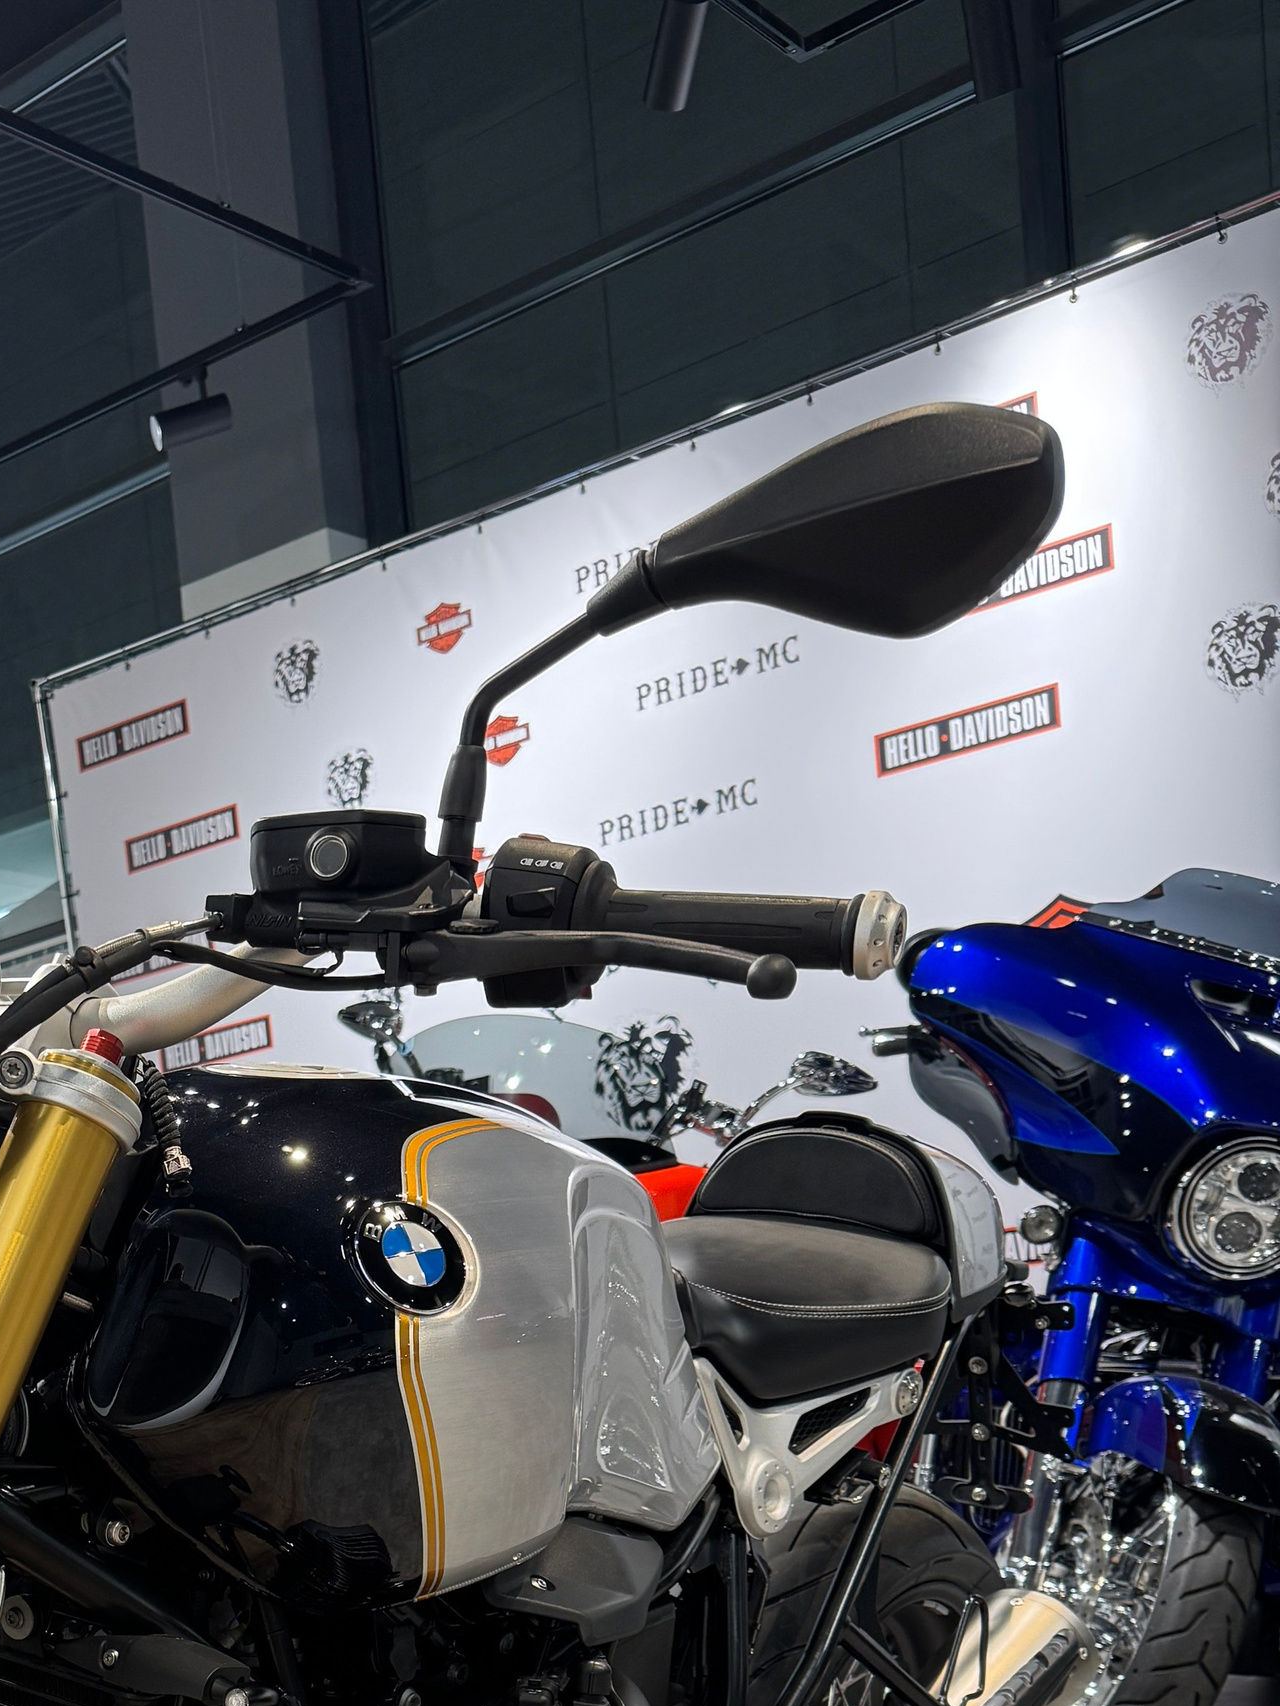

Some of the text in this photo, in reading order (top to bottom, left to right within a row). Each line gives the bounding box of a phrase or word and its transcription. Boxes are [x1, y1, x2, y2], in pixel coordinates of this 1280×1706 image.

[636, 635, 800, 711] PRIDE MC
[883, 692, 1051, 770] HELLO DAVIDSON
[599, 778, 759, 847] PRIDE MC
[363, 1205, 442, 1243] BMW
